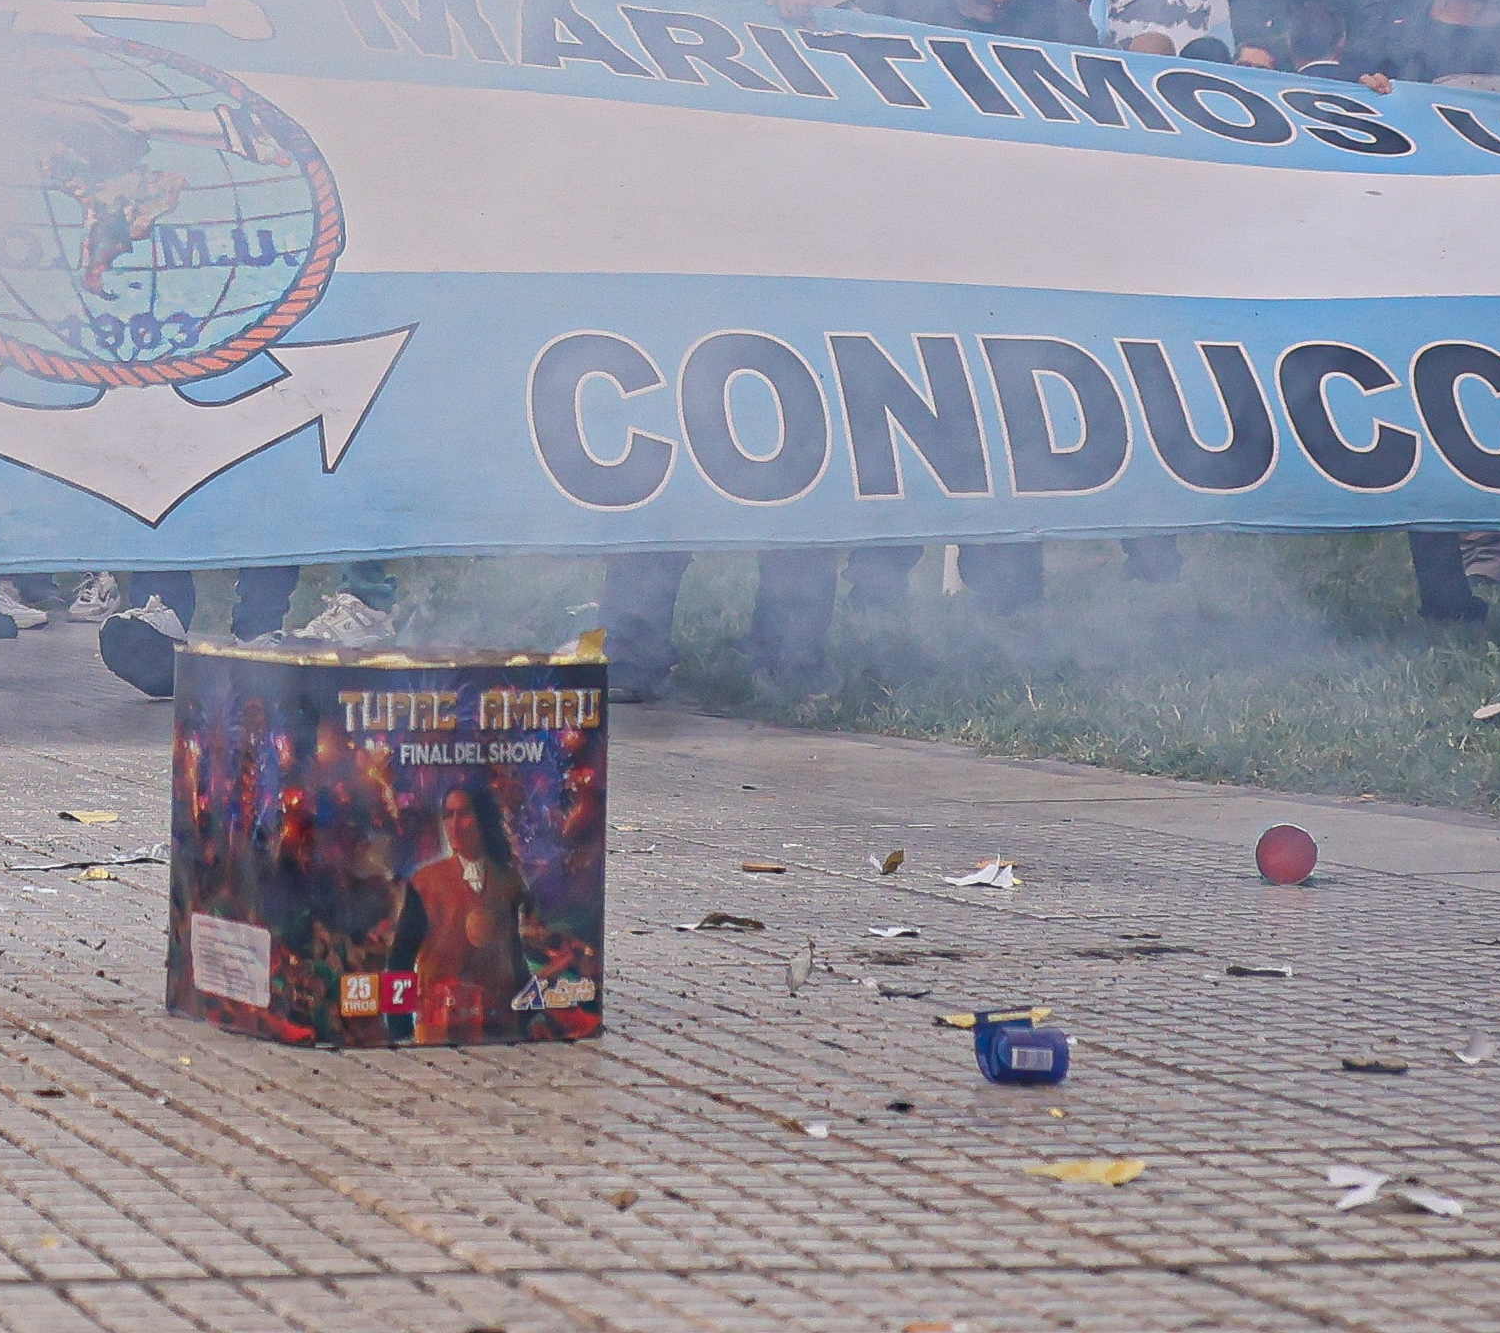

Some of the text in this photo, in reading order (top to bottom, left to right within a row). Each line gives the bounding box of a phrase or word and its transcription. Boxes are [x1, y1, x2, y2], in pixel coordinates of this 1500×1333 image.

[338, 688, 602, 732] TUPAC AMARU
[400, 740, 545, 766] FINAL DEL SHOW
[347, 976, 372, 1000] 25
